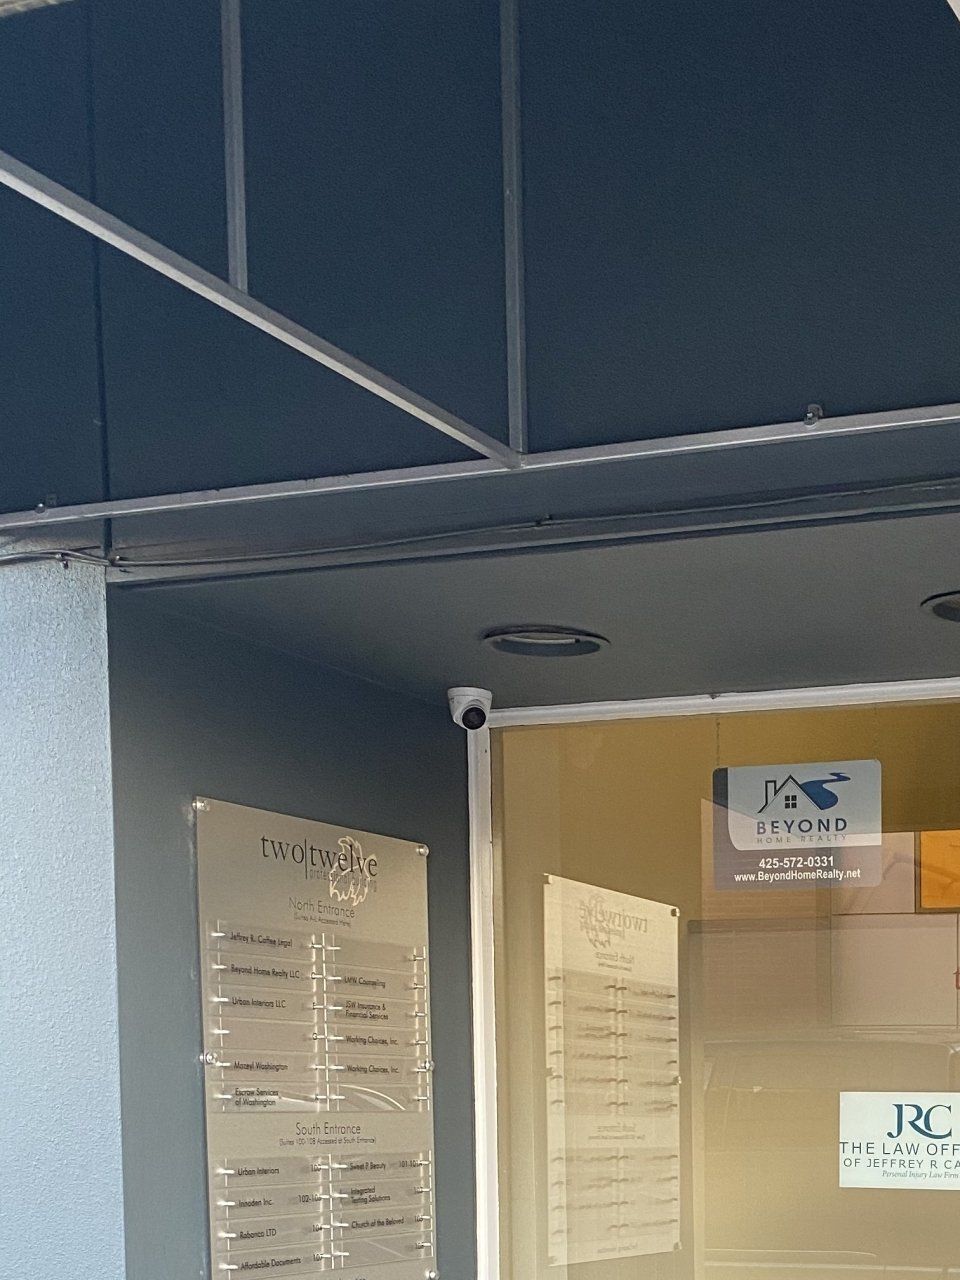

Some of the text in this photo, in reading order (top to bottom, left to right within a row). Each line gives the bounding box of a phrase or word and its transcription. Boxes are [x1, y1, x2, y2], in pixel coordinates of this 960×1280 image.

[756, 818, 847, 835] BEYOND
[801, 834, 847, 843] REALTY
[758, 856, 835, 869] 425-572-0331
[734, 868, 861, 883] www.BeyondHomeRealty.net
[288, 896, 355, 919] North Entrance
[296, 1121, 361, 1135] South Entrance
[887, 1103, 953, 1139] JRC
[839, 1141, 875, 1155] THE
[882, 1142, 920, 1155] LAW
[843, 1158, 861, 1168] OF
[866, 1158, 924, 1169] JEFFREY
[930, 1159, 938, 1169] R
[881, 1169, 959, 1180] Personal Injury Law Firm
